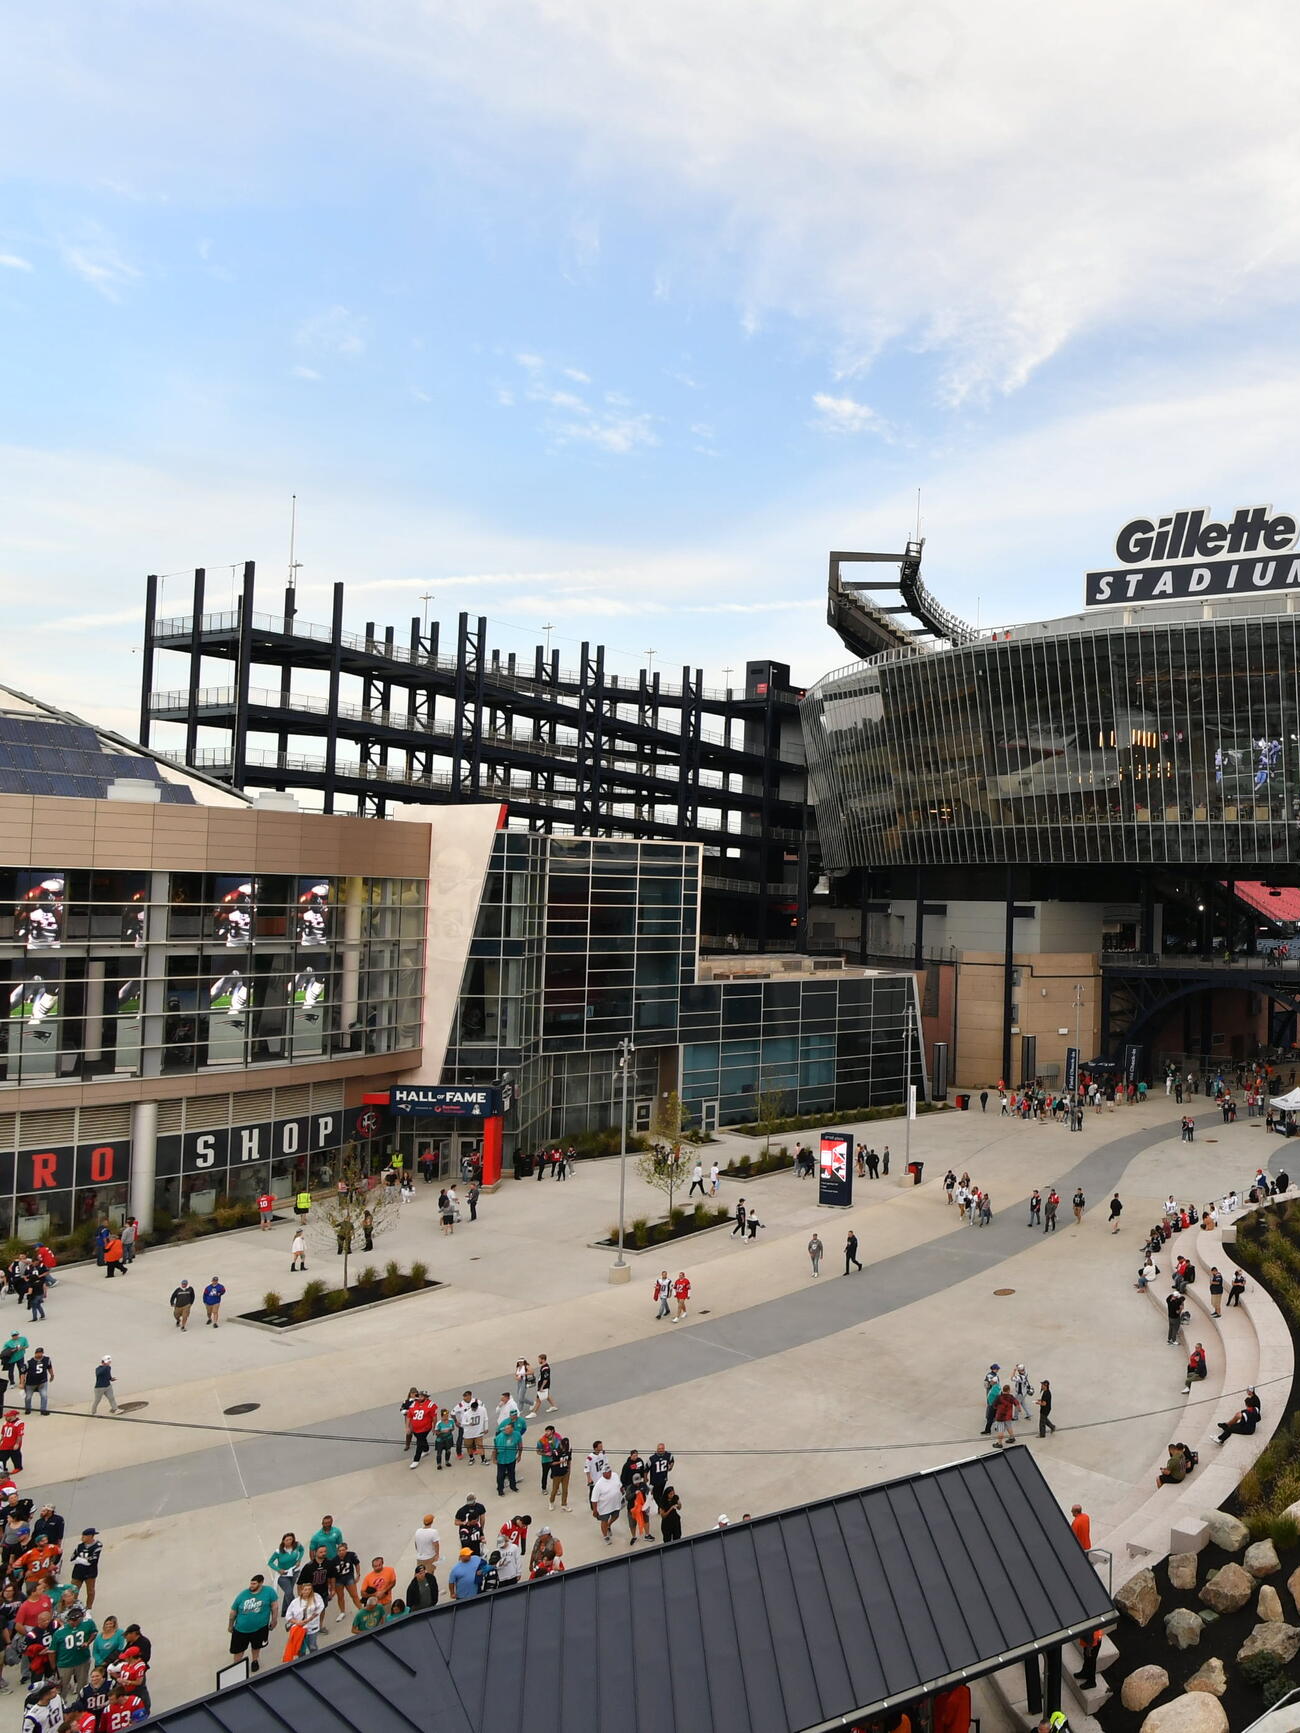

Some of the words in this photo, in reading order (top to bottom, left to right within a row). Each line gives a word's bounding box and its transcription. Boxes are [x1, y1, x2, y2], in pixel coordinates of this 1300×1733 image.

[1115, 507, 1296, 563] Gillette
[395, 1090, 437, 1102] HALL
[446, 1091, 487, 1104] FAME
[195, 1115, 334, 1168] SHOP
[35, 1363, 44, 1374] 5
[413, 1409, 425, 1421] 38
[3, 1427, 13, 1438] 10
[655, 1460, 668, 1473] 12
[471, 1531, 481, 1542] 10
[510, 1530, 518, 1543] 9
[31, 1557, 50, 1573] 34
[65, 1631, 85, 1650] 03
[87, 1694, 110, 1709] 80
[46, 1707, 63, 1728] 12
[111, 1710, 132, 1731] 23
